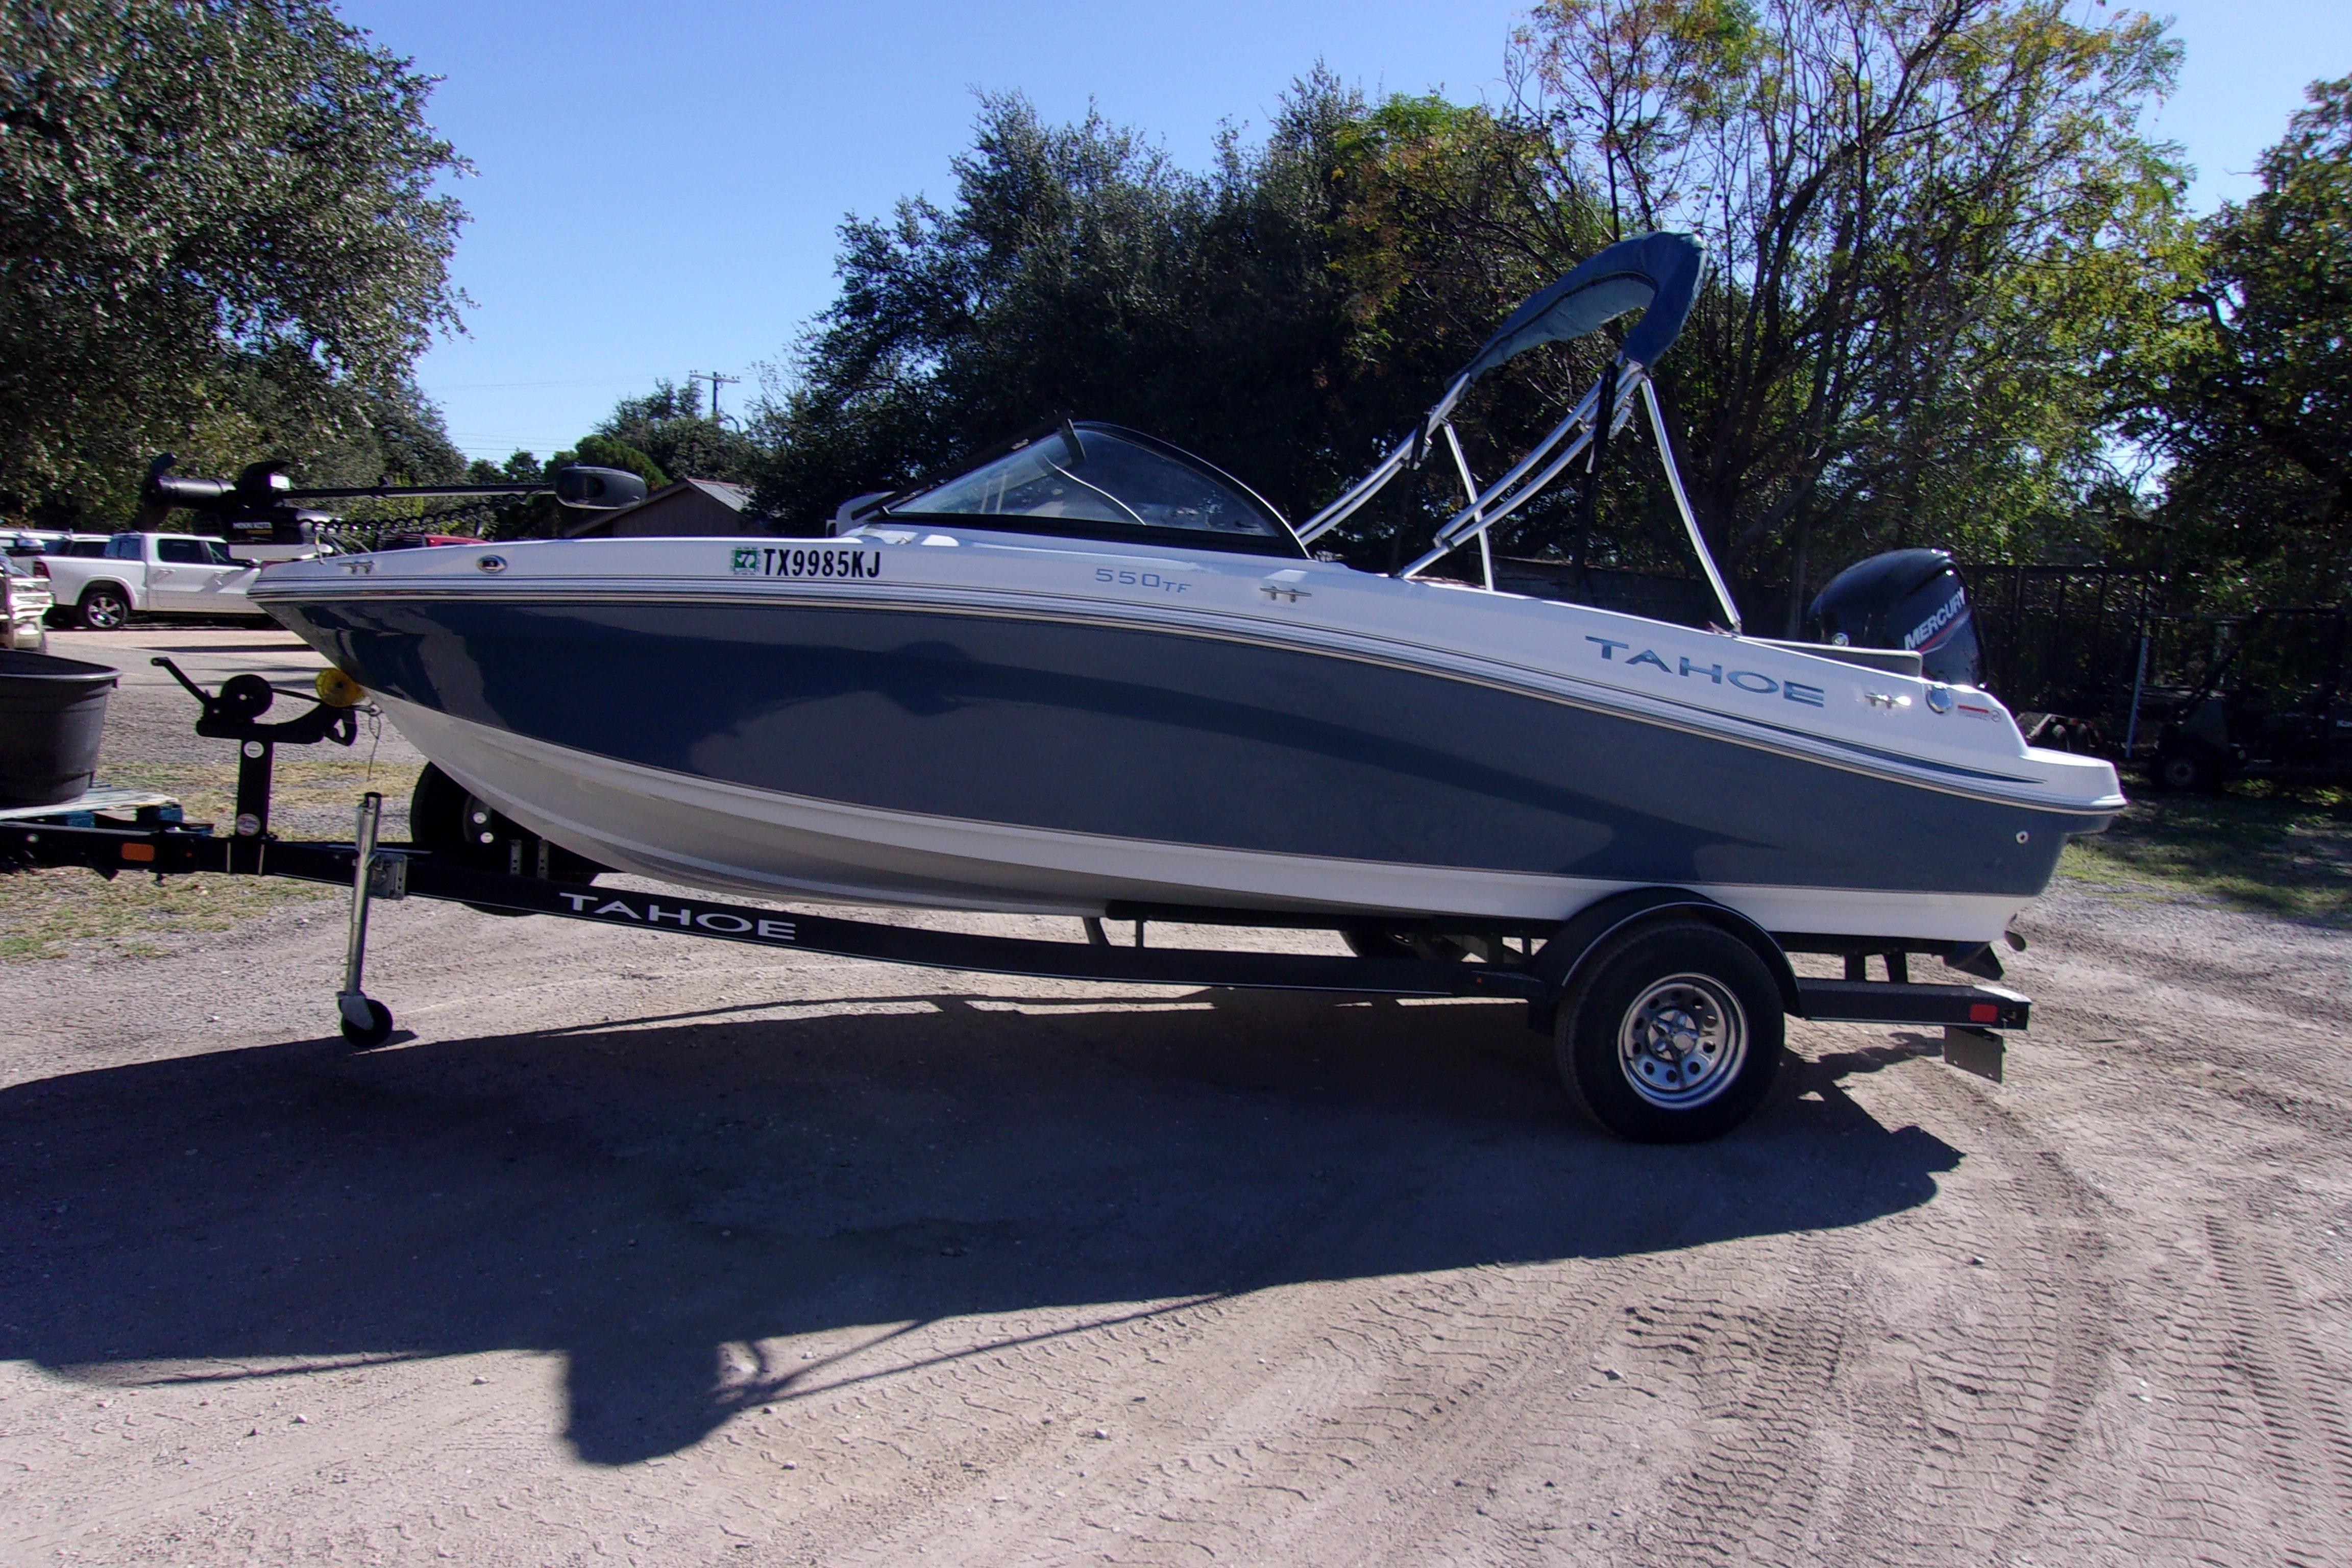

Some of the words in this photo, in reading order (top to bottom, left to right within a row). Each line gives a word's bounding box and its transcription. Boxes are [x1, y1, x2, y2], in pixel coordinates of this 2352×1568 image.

[764, 548, 880, 577] TX9985KJ
[1904, 586, 1966, 650] MERCURY
[1585, 635, 1824, 707] TAHOE
[559, 892, 796, 940] TAHOE
